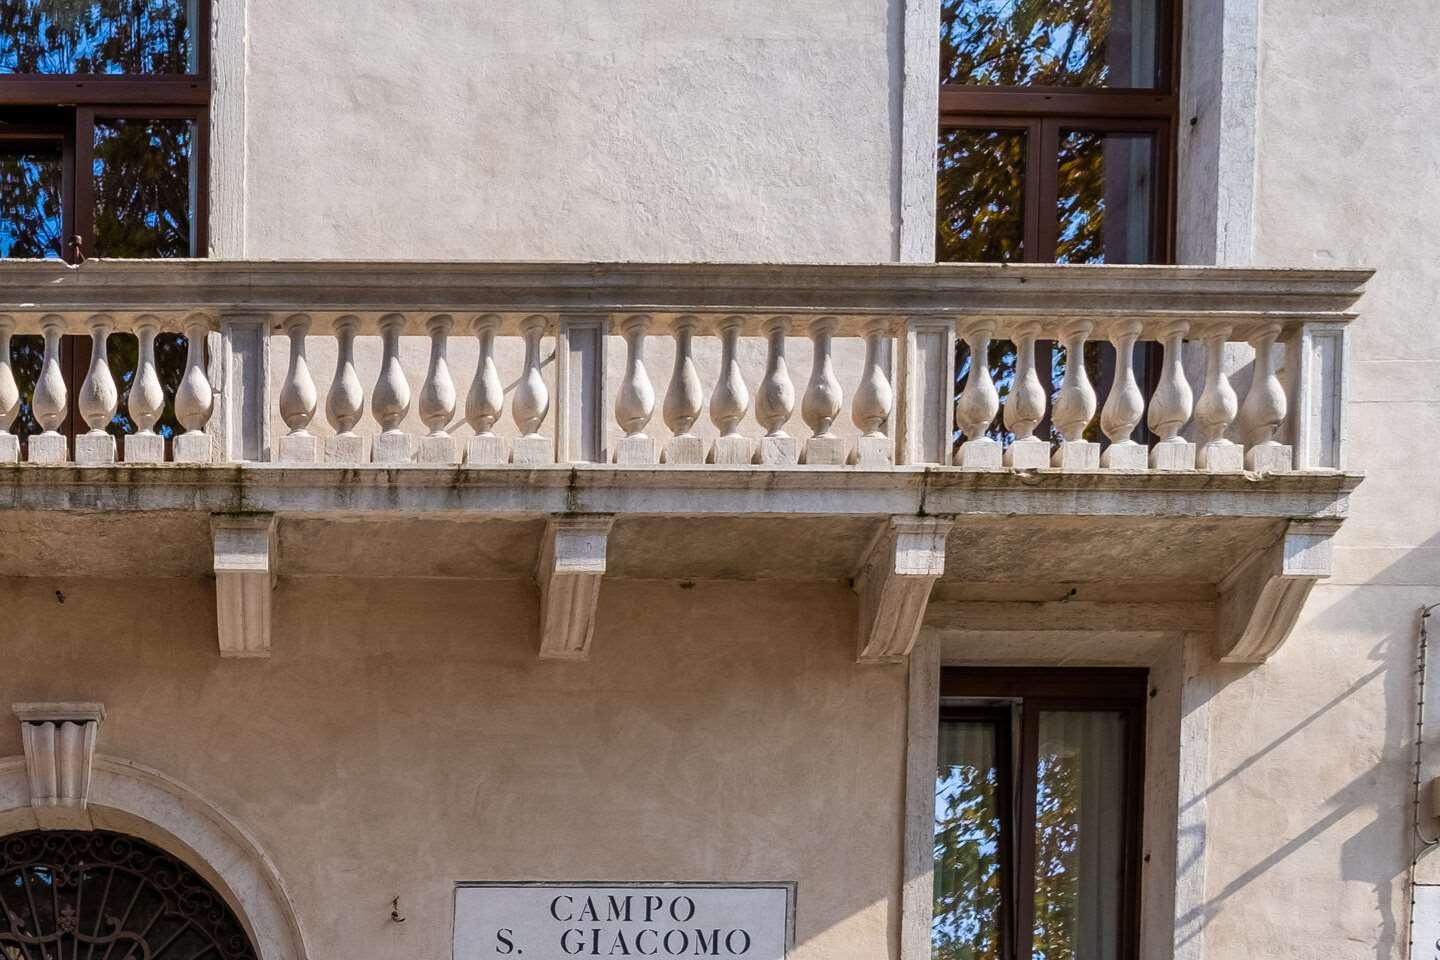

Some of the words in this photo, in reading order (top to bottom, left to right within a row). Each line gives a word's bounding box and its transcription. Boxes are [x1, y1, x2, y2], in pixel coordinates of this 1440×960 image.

[549, 895, 696, 923] CAMPO
[495, 928, 523, 955] S.
[560, 928, 751, 956] GIACOMO
